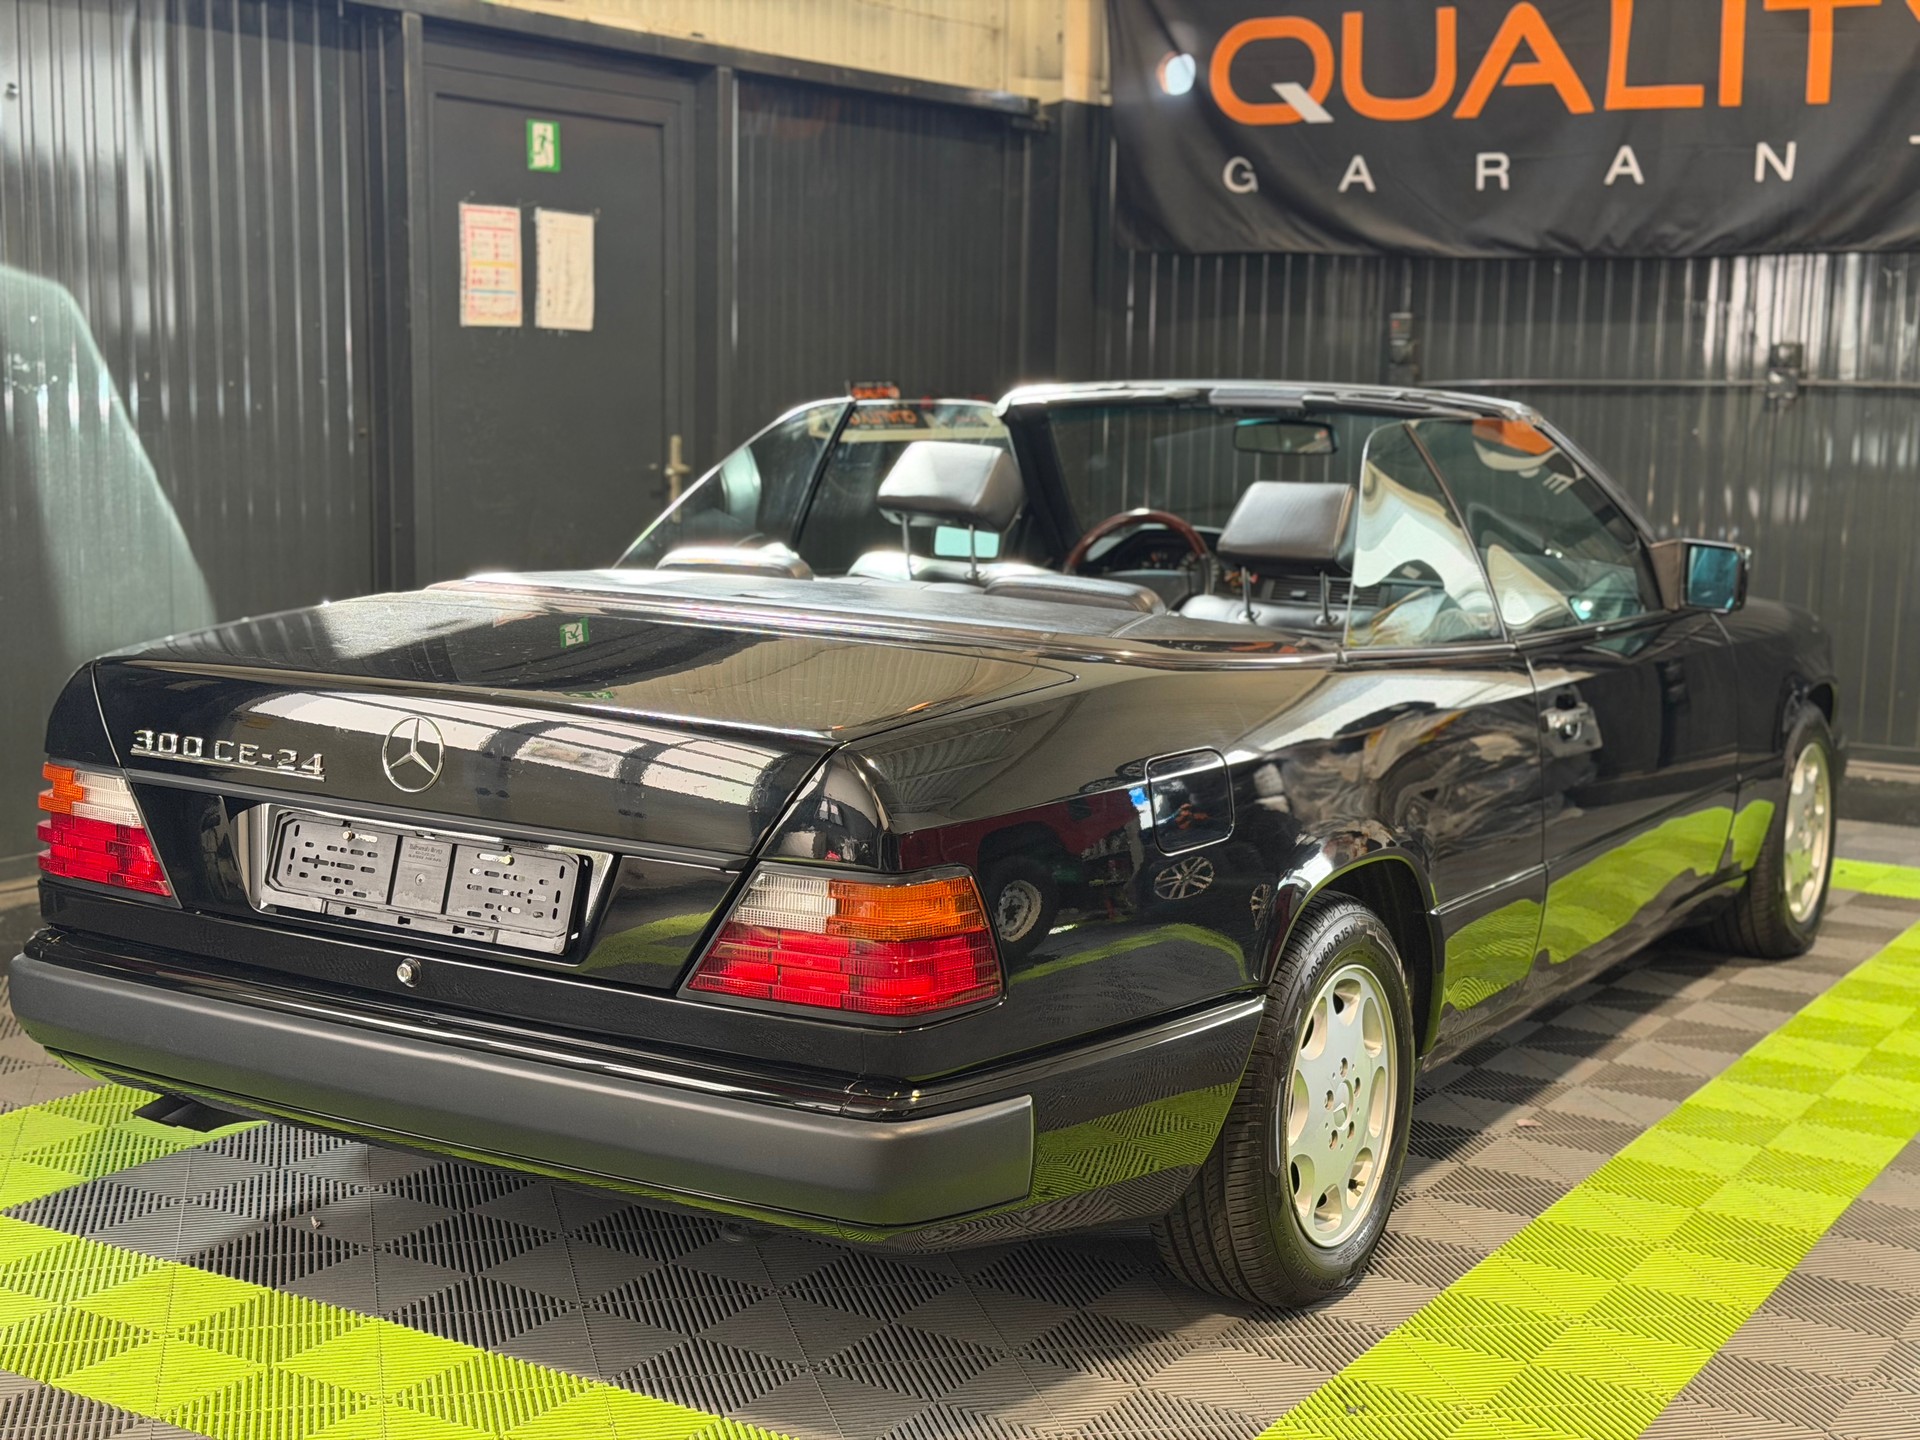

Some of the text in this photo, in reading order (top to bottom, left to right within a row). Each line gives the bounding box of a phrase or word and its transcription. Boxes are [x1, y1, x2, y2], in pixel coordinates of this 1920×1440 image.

[1209, 0, 1920, 125] QUALIT
[1222, 135, 1920, 193] GARAN
[132, 729, 325, 775] 300 CE-24
[1306, 941, 1334, 984] 205/60
[1340, 926, 1351, 941] 15
